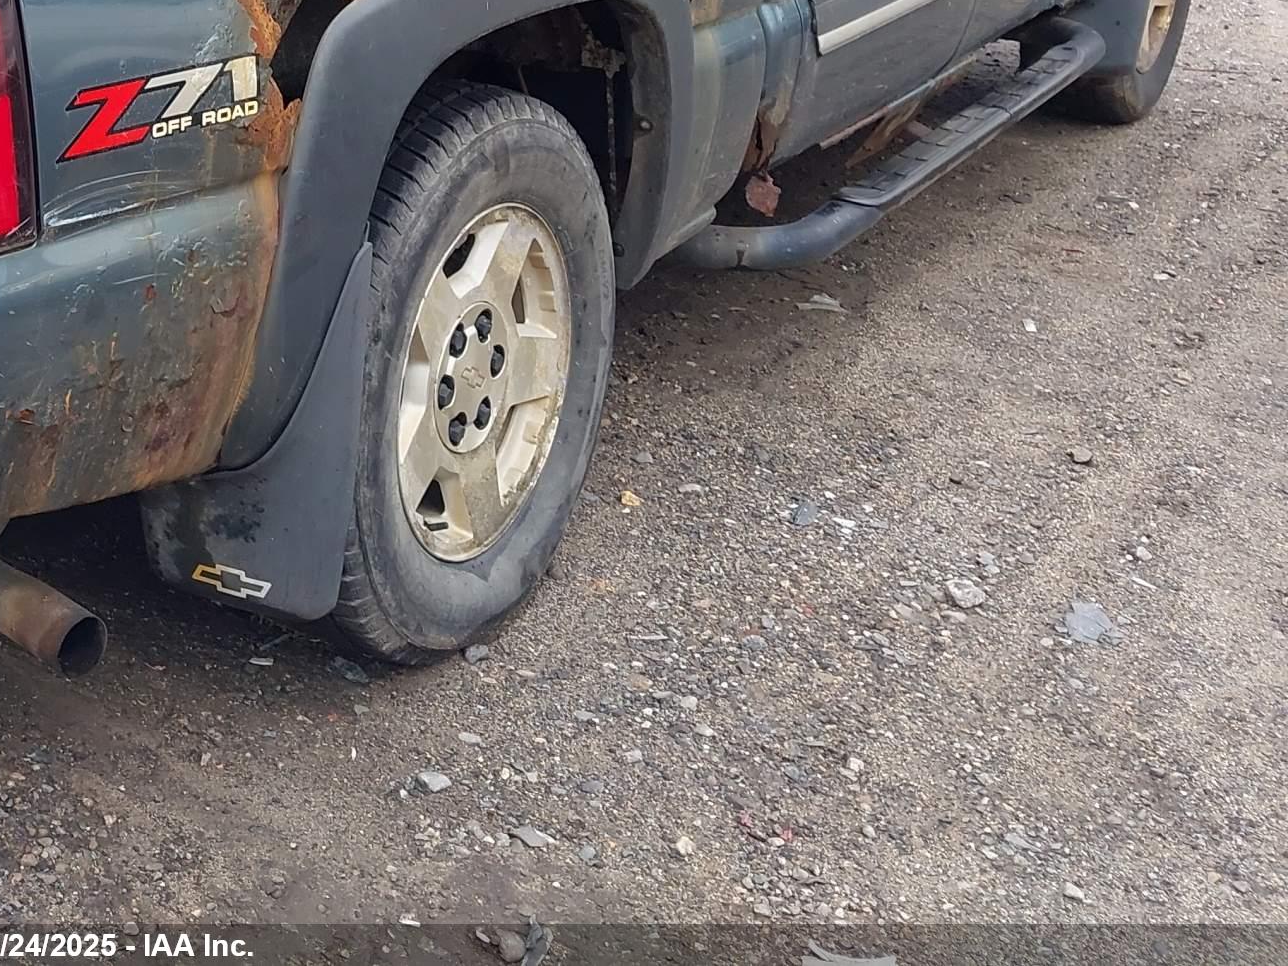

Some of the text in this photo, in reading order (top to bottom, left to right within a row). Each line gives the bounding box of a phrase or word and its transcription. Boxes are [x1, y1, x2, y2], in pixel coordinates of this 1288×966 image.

[56, 54, 258, 163] Z71
[151, 100, 259, 139] OFF ROAD
